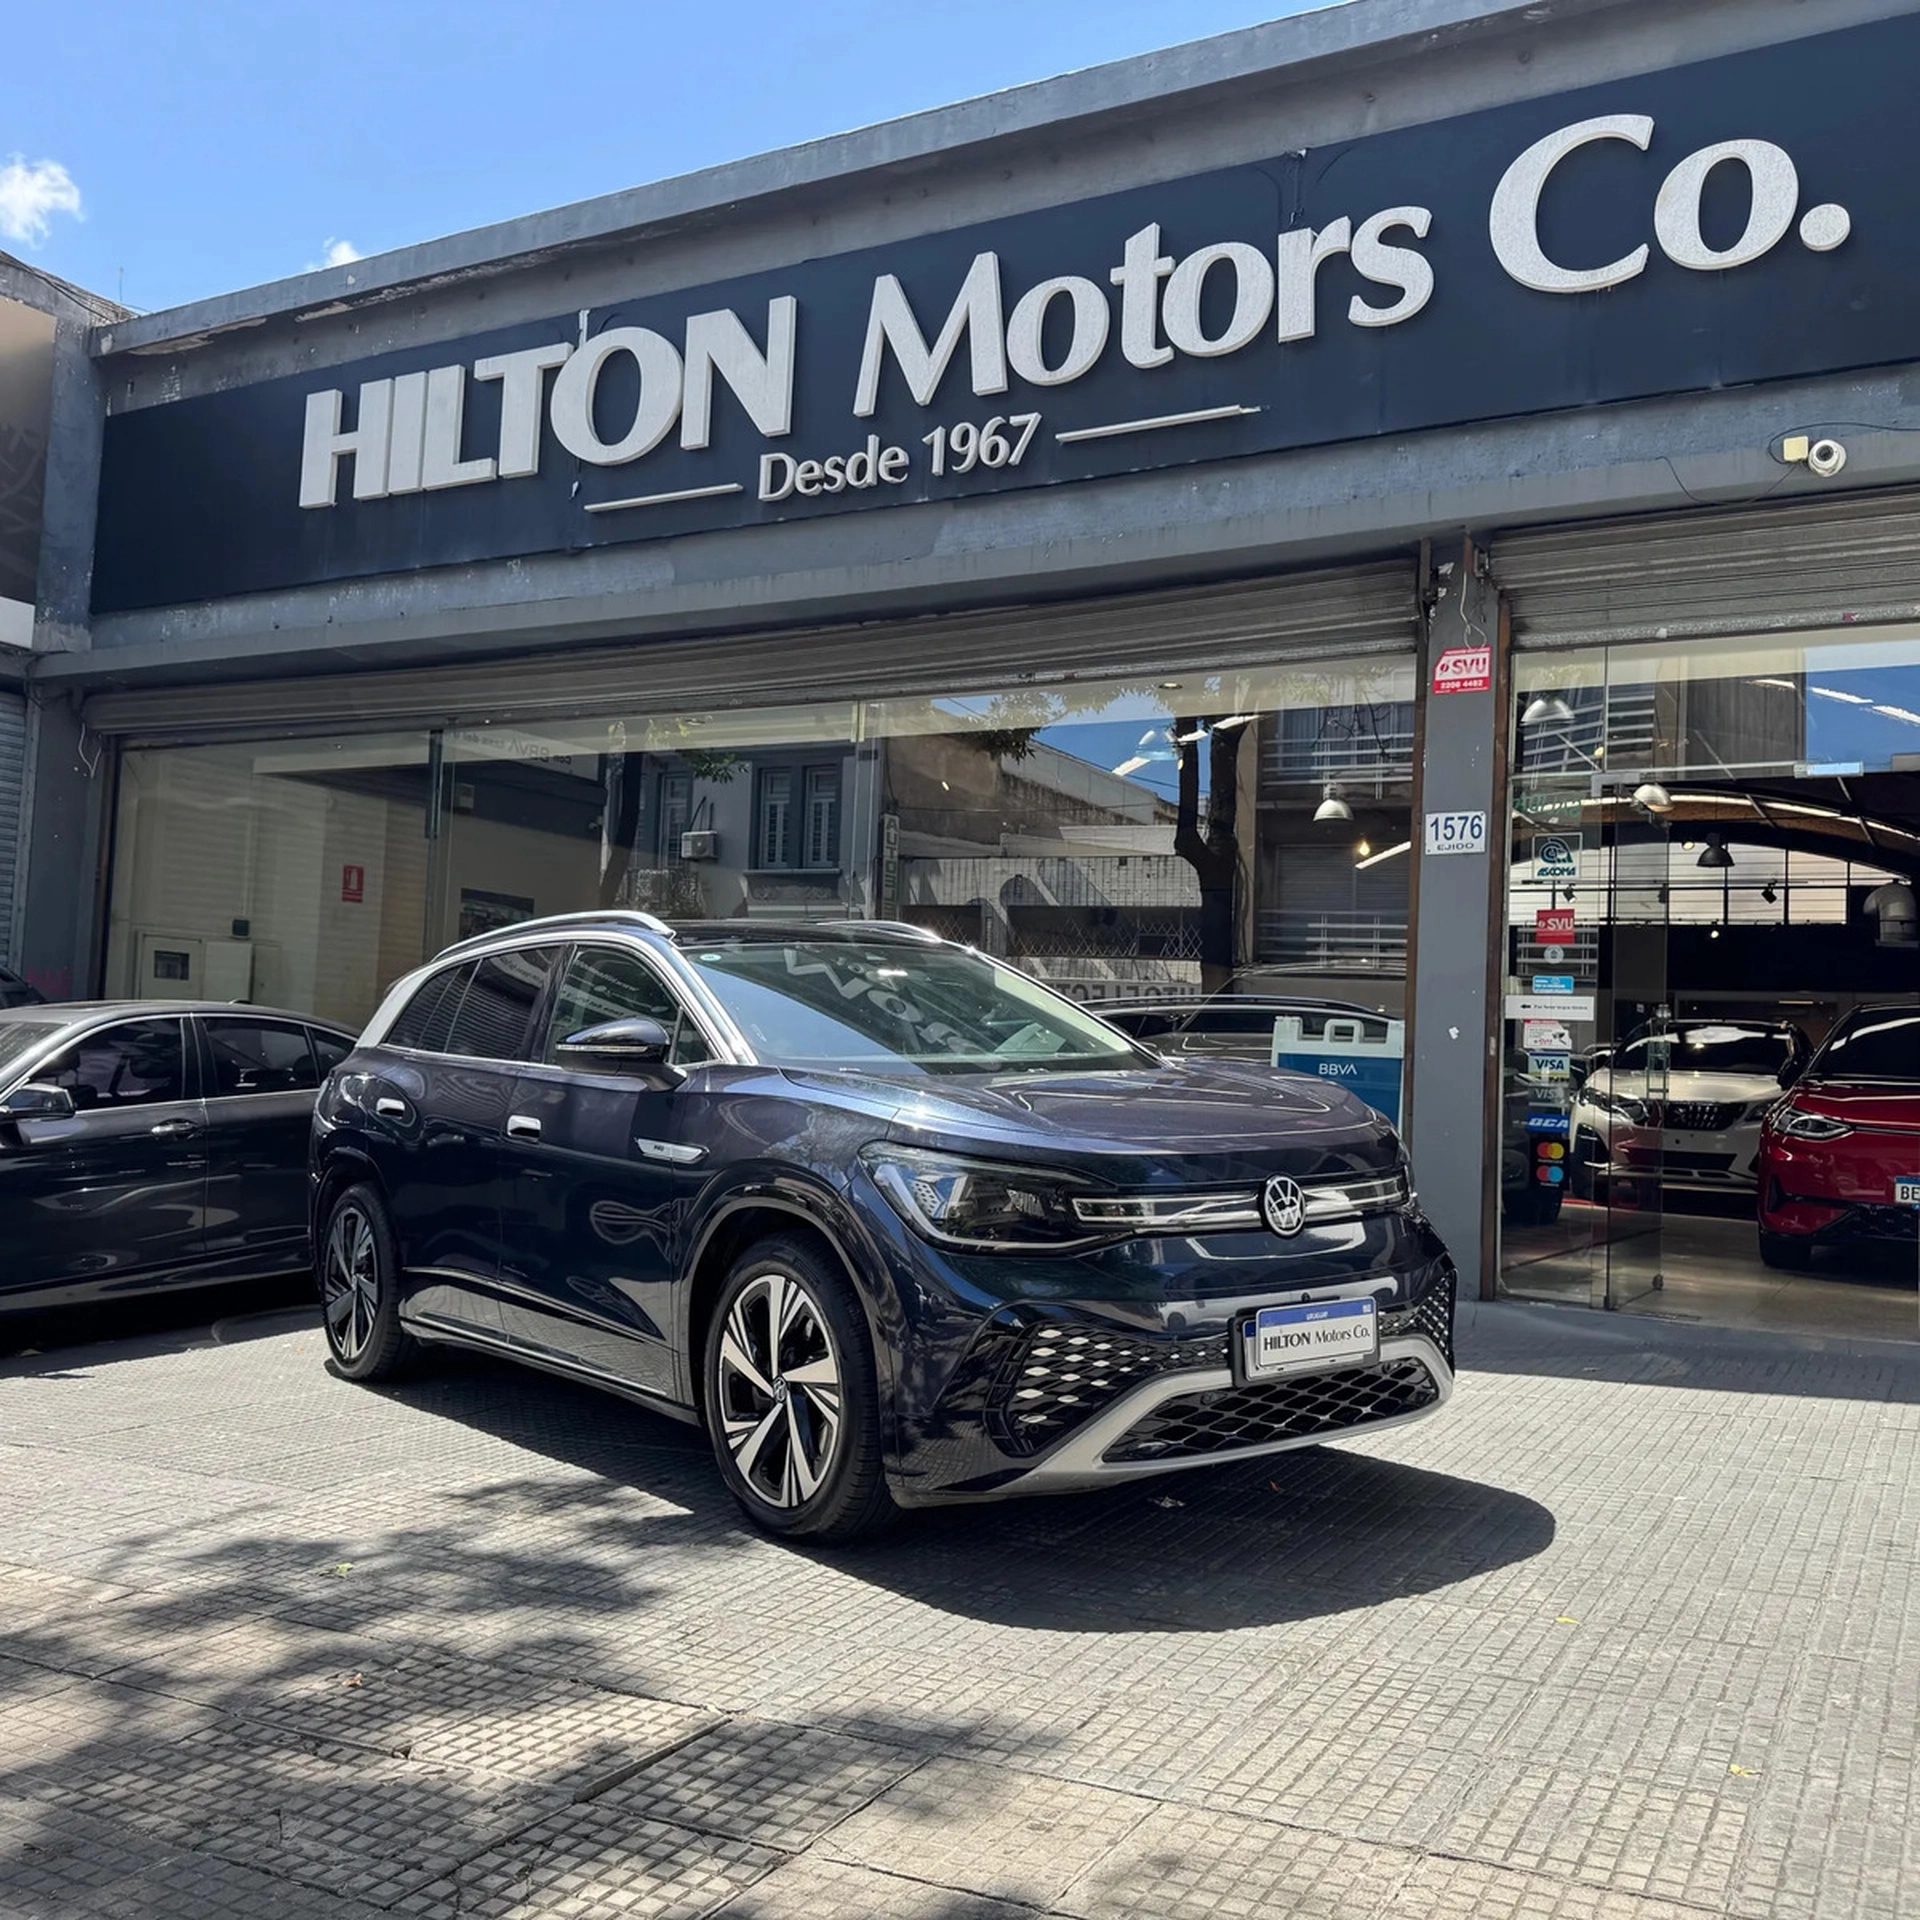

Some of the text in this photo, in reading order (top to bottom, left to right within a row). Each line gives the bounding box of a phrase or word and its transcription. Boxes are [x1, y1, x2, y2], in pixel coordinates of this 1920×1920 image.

[299, 113, 1851, 509] HILTON Motors Co.
[758, 412, 1043, 502] Desde 1967
[1451, 657, 1487, 675] SVU
[1430, 814, 1483, 842] 1576
[1547, 917, 1574, 931] SVU
[1318, 1063, 1358, 1076] BBVA
[1535, 1059, 1565, 1070] VISA
[1263, 1324, 1371, 1351] HILTON Motors Co.
